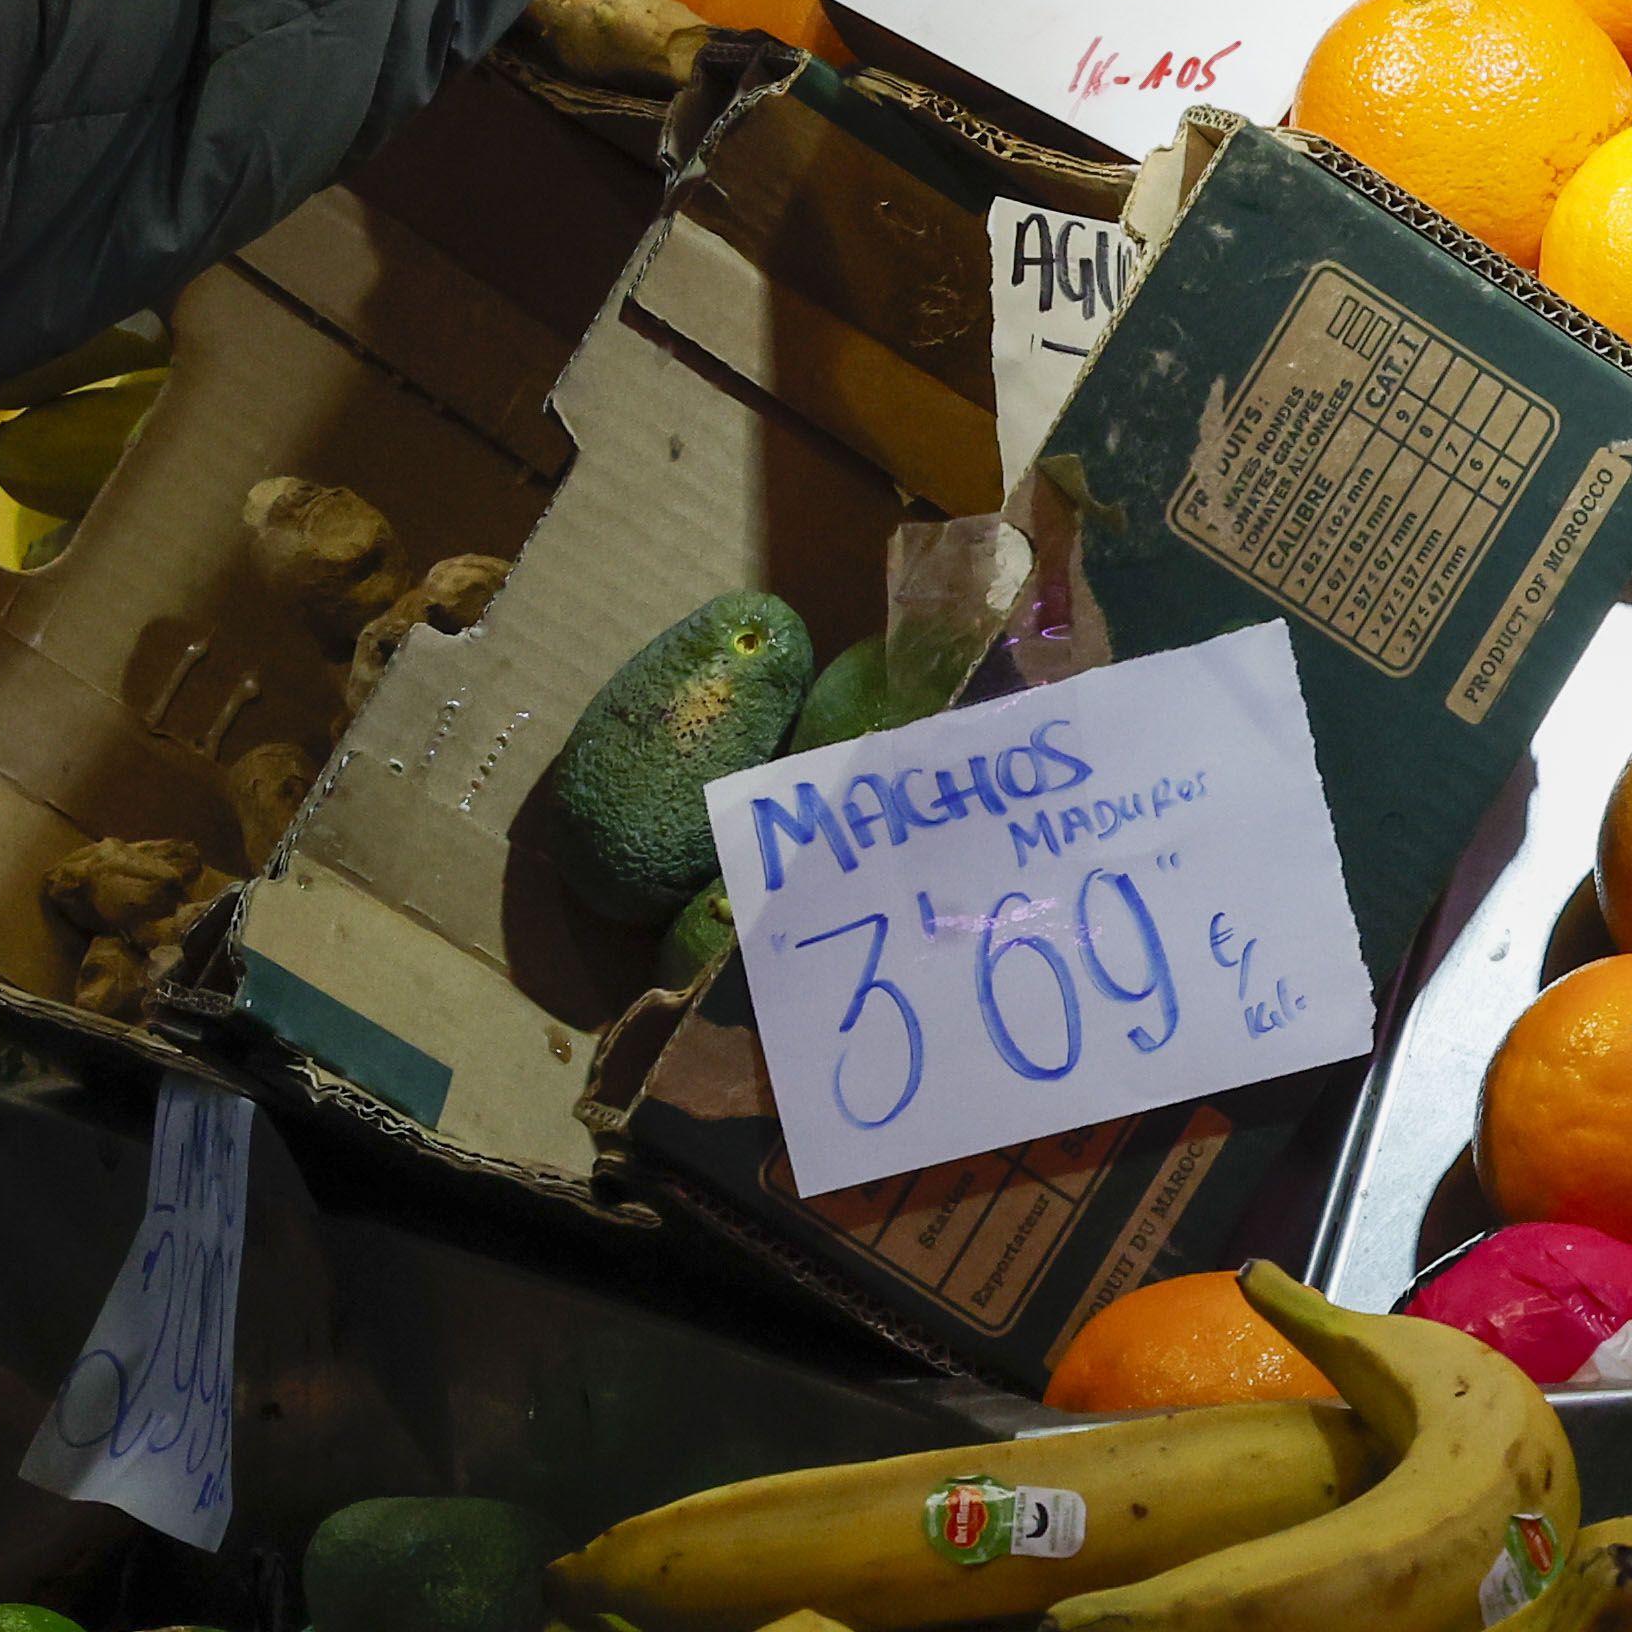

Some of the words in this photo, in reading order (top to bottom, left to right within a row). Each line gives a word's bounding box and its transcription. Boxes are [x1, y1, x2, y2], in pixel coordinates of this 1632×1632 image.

[1184, 405, 1263, 520] PRDUITS
[1231, 466, 1278, 535] OMATES
[1272, 388, 1325, 467] GRAPPES
[1256, 386, 1305, 456] RONDES
[1268, 473, 1334, 570] CALIBRE
[1365, 353, 1411, 410] CAT.
[1347, 467, 1376, 505] mm
[1395, 408, 1411, 424] 9
[1365, 493, 1394, 530] mm
[1419, 424, 1434, 439] 8
[1239, 476, 1293, 555] TOMATES
[1373, 546, 1396, 571] 67
[1390, 511, 1419, 548] mm
[1444, 441, 1460, 458] 7
[1379, 600, 1399, 626] 47
[1415, 528, 1444, 565] mm
[1469, 457, 1484, 472] 6
[1404, 617, 1423, 644] 37
[1426, 580, 1446, 607] 47
[1440, 543, 1468, 582] mm
[1495, 475, 1512, 491] 5
[1463, 605, 1528, 704] PRODUCT
[1524, 572, 1550, 605] OF
[1543, 467, 1614, 572] MOROCCO
[751, 718, 1094, 893] MACHOS
[1008, 770, 1208, 868] MADUROS
[917, 1171, 977, 1250] Station
[970, 1192, 1052, 1309] Exportateur
[1128, 1217, 1156, 1253] DU
[1159, 1141, 1205, 1220] MAROC
